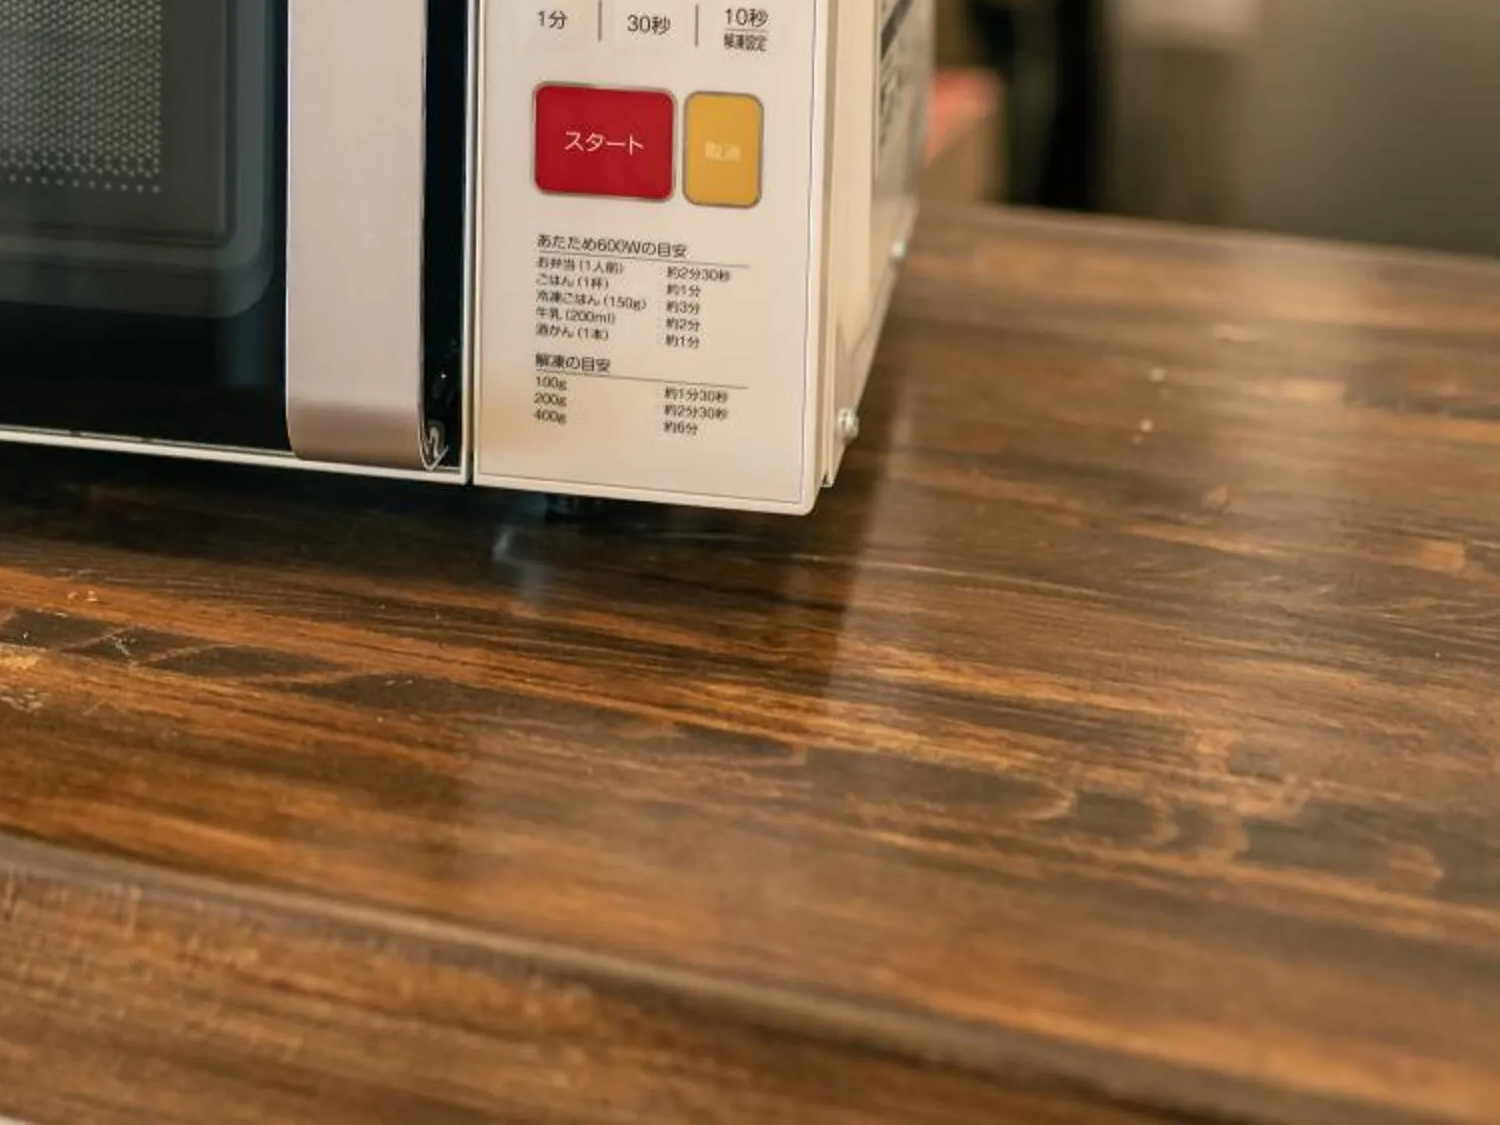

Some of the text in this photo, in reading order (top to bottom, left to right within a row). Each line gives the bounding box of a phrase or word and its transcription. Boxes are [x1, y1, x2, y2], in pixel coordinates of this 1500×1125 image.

[537, 10, 568, 29] 1分
[627, 15, 671, 35] 30秒
[725, 7, 769, 28] 10秒
[564, 131, 644, 156] スタート
[535, 353, 611, 372] 解凍の目安
[534, 392, 567, 407] 200g
[533, 409, 567, 424] 400g
